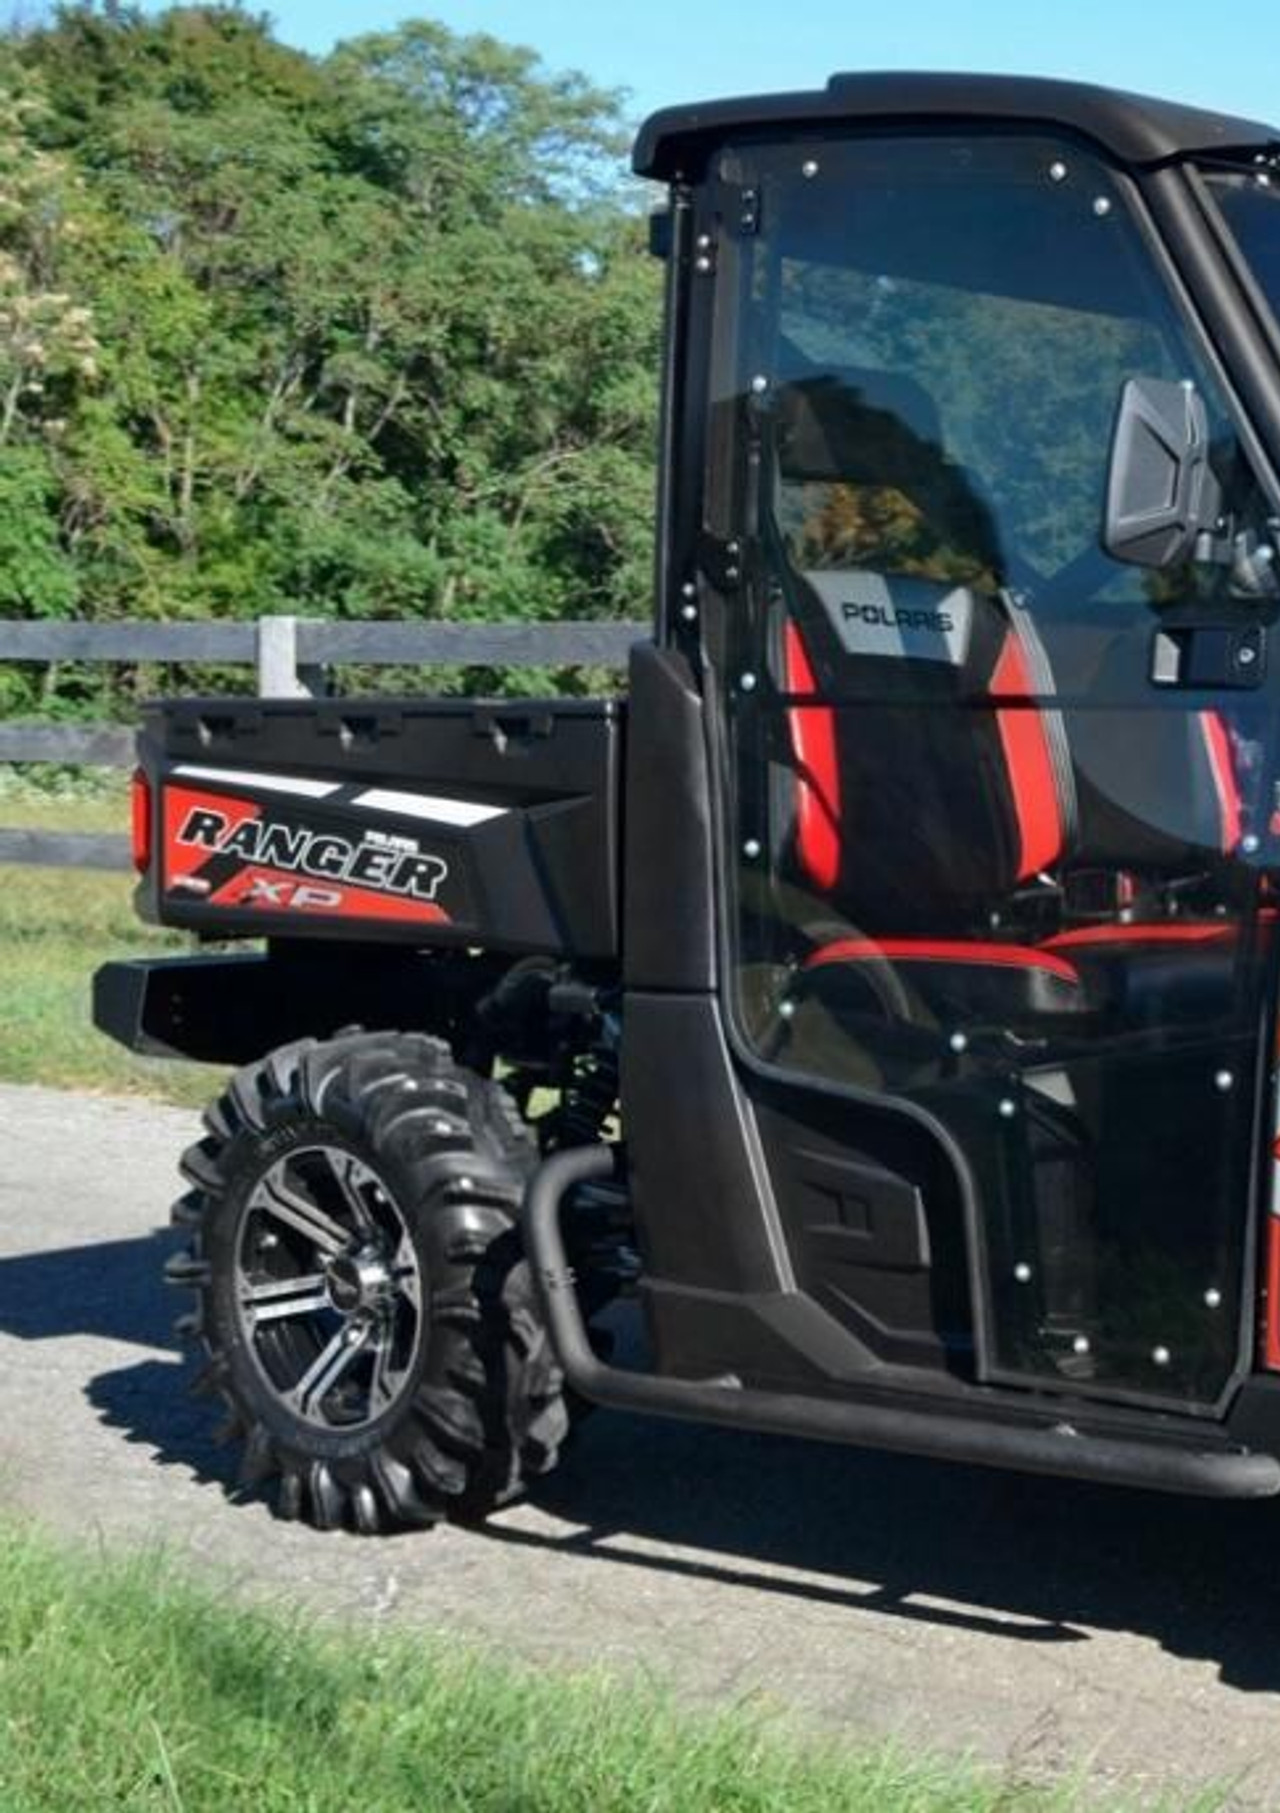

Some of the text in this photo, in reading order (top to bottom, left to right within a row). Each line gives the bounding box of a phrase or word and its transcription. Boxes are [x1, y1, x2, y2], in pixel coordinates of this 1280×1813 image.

[842, 602, 954, 632] POLARIS
[179, 807, 448, 899] RANGER
[245, 879, 343, 906] XP
